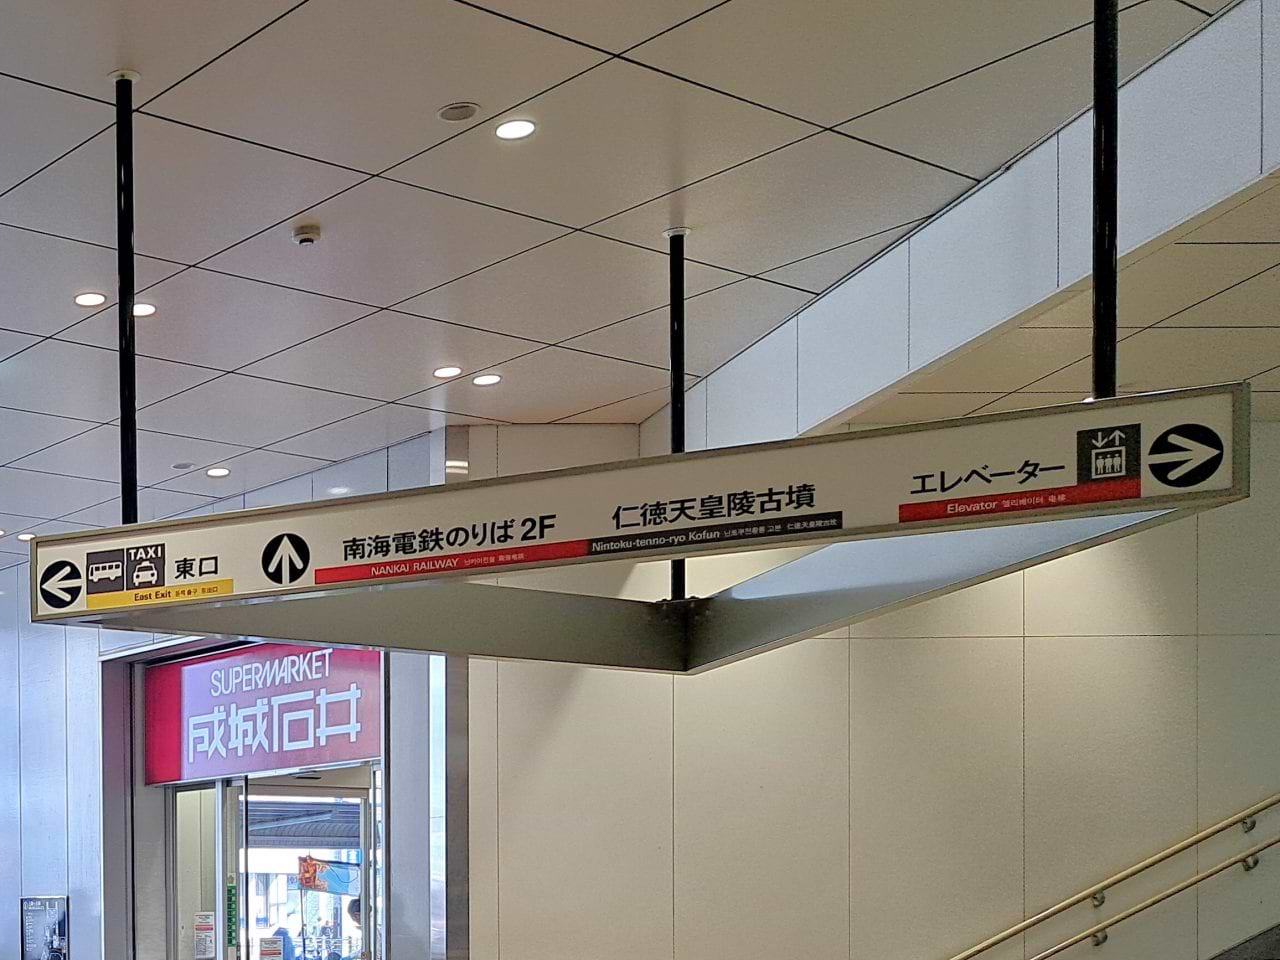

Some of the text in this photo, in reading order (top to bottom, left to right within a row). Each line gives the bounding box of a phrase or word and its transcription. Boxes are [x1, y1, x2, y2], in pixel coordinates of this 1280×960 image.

[910, 459, 1066, 495] エレベーター
[612, 483, 816, 531] 仁徳天皇陵古墳
[946, 500, 998, 514] Elevator
[342, 514, 557, 561] 南海電鉄のりば 2F
[591, 529, 720, 552] Nintoku-tenno-ryo Kofun
[129, 546, 162, 560] TAXI
[174, 556, 219, 580] 東口
[371, 557, 460, 576] NANKAI RAILWAY
[134, 590, 172, 602] East Exit
[210, 648, 333, 697] SUPERMARKET
[188, 682, 361, 764] 成城石井
